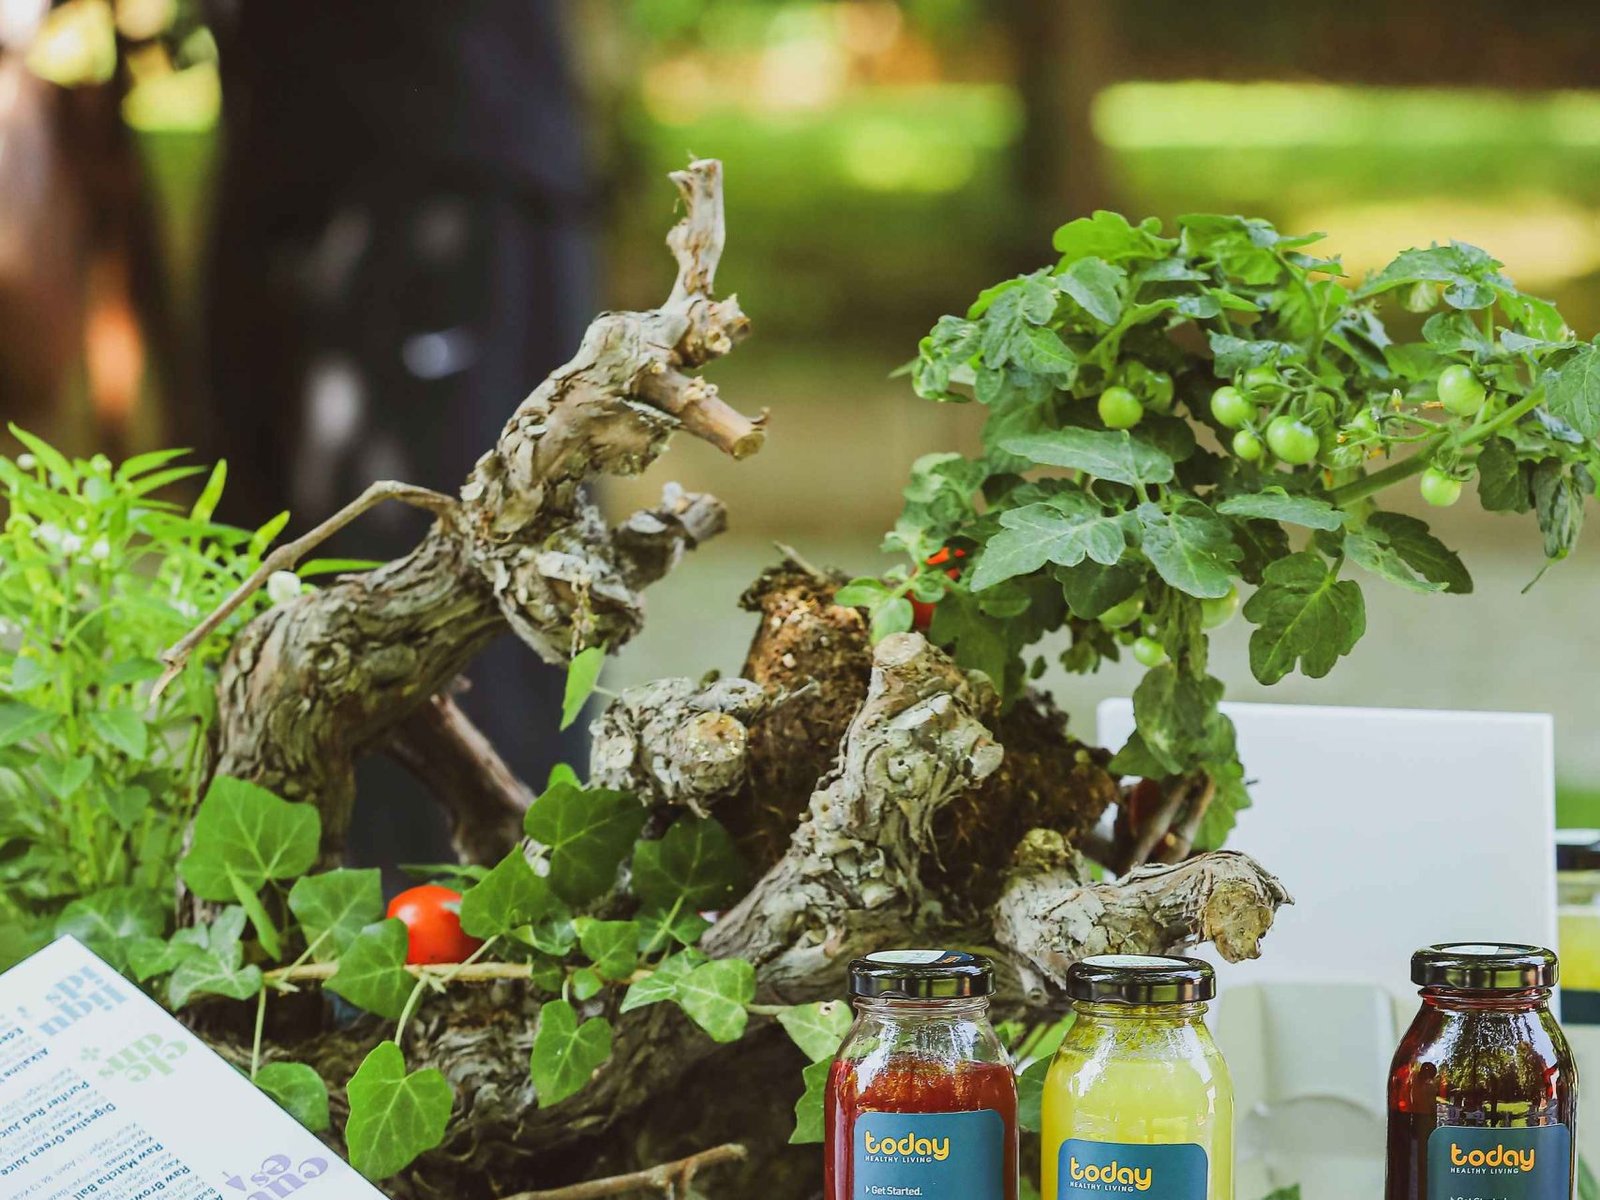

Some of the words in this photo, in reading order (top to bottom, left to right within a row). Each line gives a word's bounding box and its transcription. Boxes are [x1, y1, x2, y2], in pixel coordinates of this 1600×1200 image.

[22, 1107, 46, 1124] Red
[64, 1102, 116, 1135] Digestive
[29, 1134, 65, 1157] Green
[138, 1142, 163, 1160] Raw
[865, 1131, 949, 1160] today
[1451, 1143, 1535, 1171] today
[96, 1158, 138, 1184] Matcha
[165, 1165, 190, 1182] Raw
[1070, 1156, 1152, 1191] today
[72, 1183, 98, 1200] Ball
[872, 1186, 886, 1195] Get
[887, 1186, 922, 1196] Started.
[1069, 1181, 1100, 1191] HEALTHY
